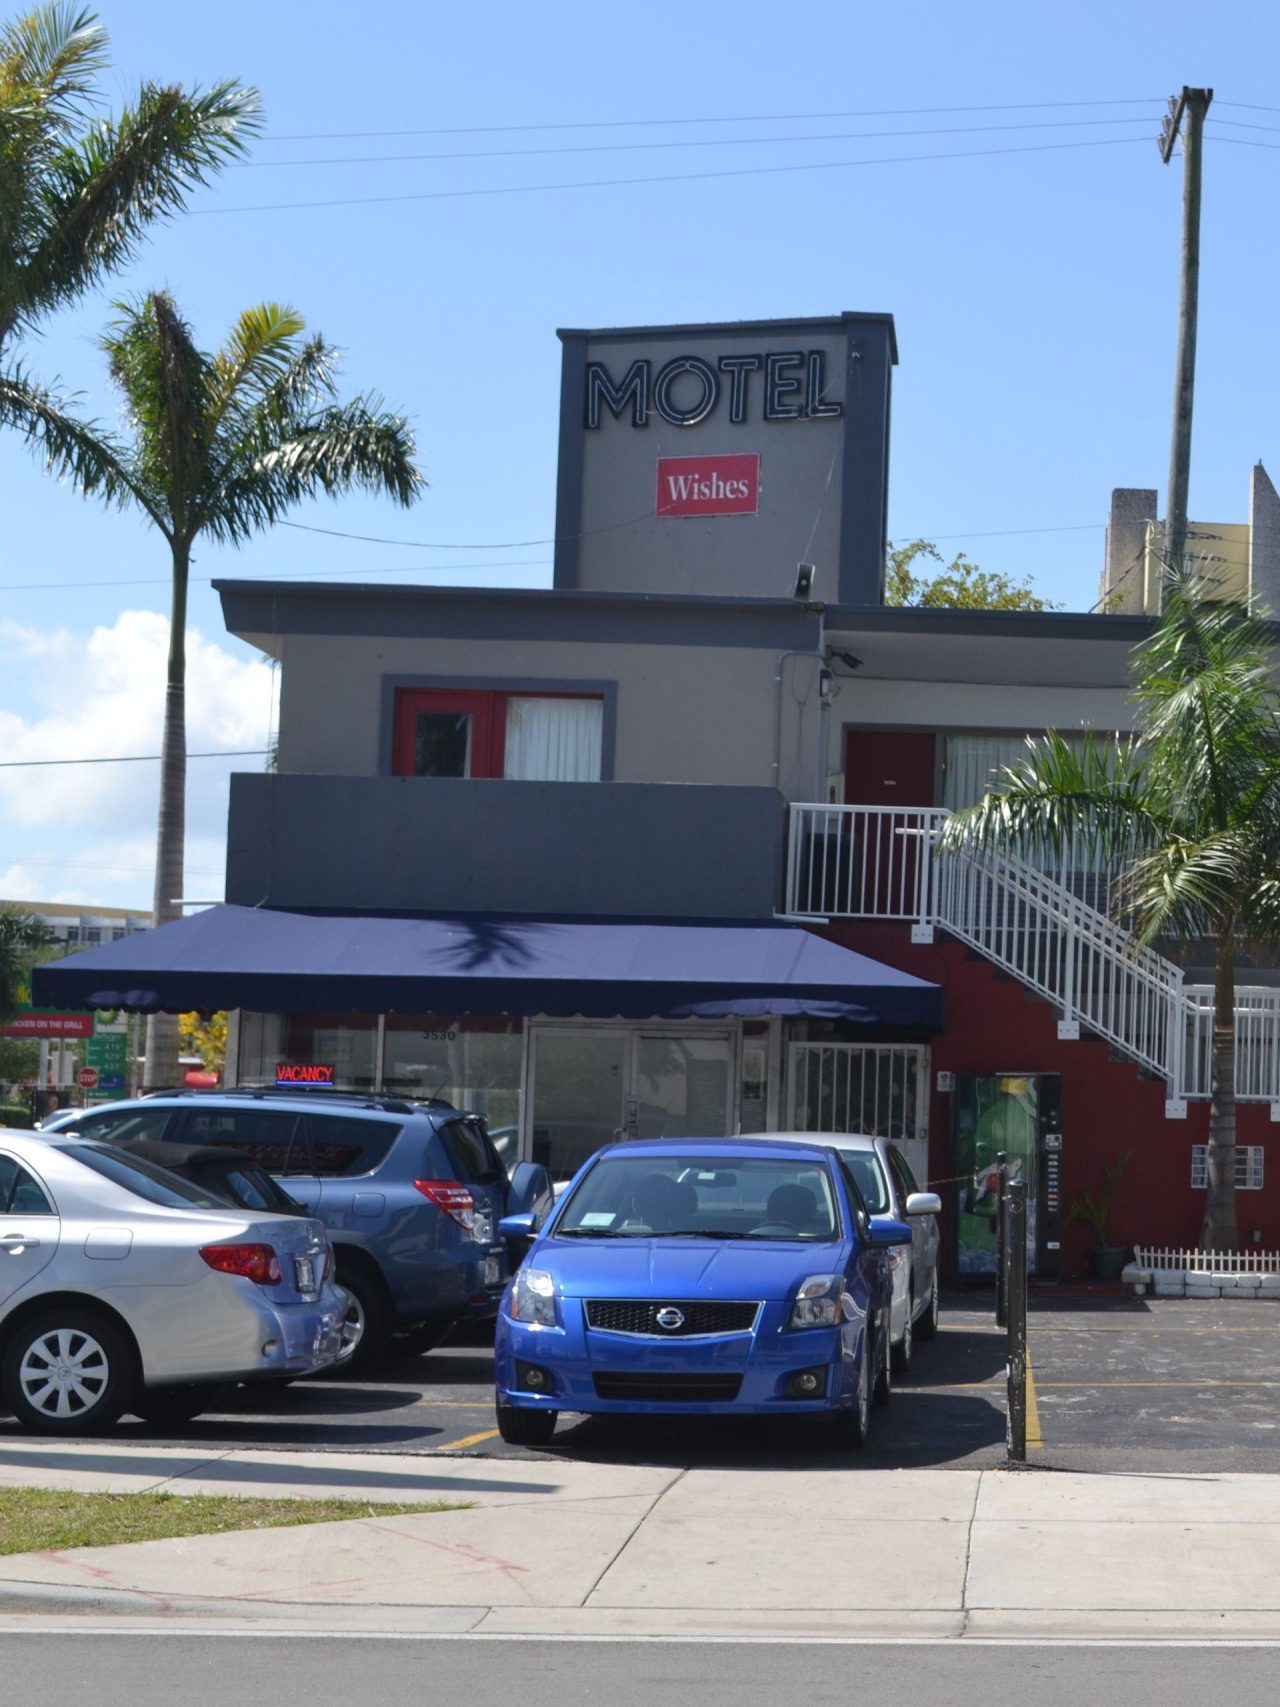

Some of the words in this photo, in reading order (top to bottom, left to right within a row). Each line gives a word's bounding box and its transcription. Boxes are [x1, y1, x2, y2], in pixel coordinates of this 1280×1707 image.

[584, 350, 843, 430] MOTEL
[667, 472, 748, 500] Wishes
[37, 1020, 48, 1028] ON
[49, 1020, 62, 1029] THE
[64, 1021, 83, 1030] GRILL
[423, 1031, 456, 1040] 3530
[79, 1073, 97, 1082] STOP
[277, 1066, 333, 1081] VACANCY
